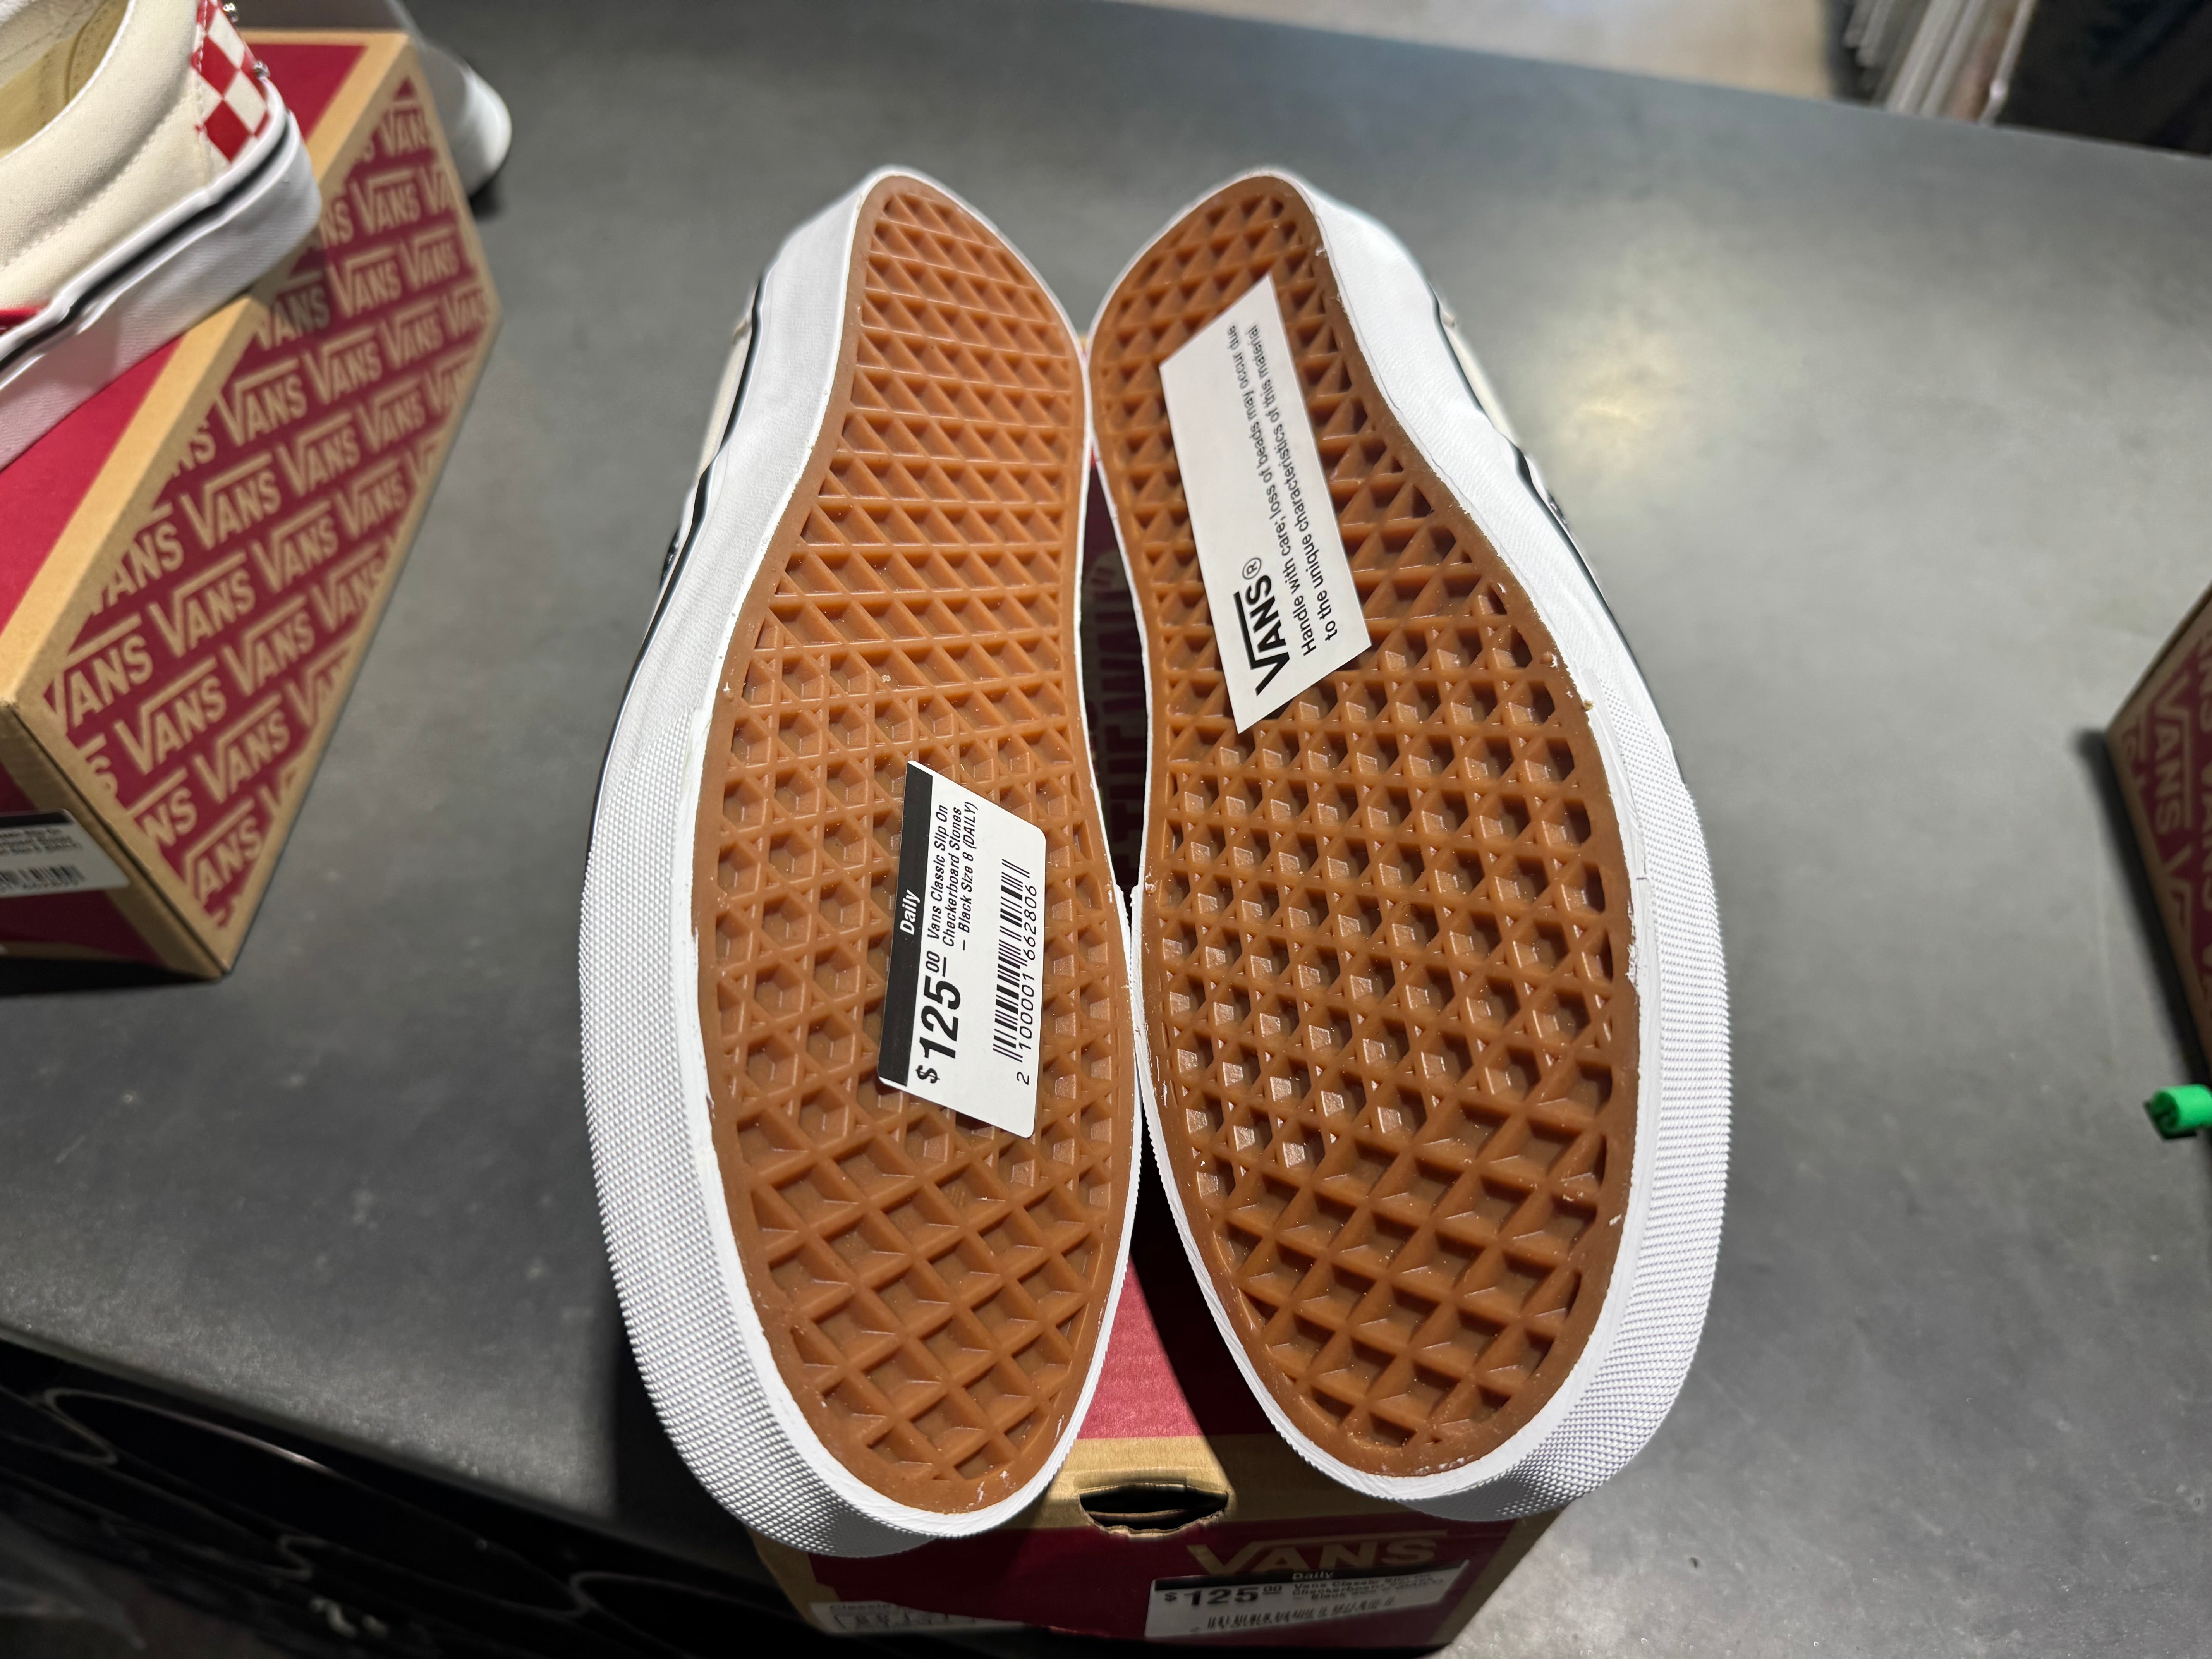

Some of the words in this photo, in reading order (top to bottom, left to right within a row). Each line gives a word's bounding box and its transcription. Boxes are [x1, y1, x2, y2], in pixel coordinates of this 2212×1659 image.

[350, 168, 421, 235] VANS
[326, 243, 403, 318] VANS
[396, 223, 461, 292] VANS
[1227, 325, 1240, 350] due
[1245, 325, 1269, 379] material
[214, 357, 308, 447] VANS
[302, 326, 382, 405] VANS
[378, 297, 444, 371] VANS
[1232, 352, 1249, 389] occur
[1242, 390, 1257, 422] may
[1260, 379, 1276, 408] this
[1265, 407, 1280, 423] of
[180, 452, 283, 551] VANS
[277, 410, 361, 499] VANS
[356, 376, 427, 453] VANS
[1249, 421, 1268, 469] beads
[1258, 467, 1273, 484] of
[1273, 424, 1309, 532] characteristics
[1266, 484, 1281, 520] loss
[148, 552, 256, 658] VANS
[251, 500, 339, 592] VANS
[336, 457, 409, 540] VANS
[1274, 516, 1291, 556] care;
[1282, 557, 1300, 595] with
[1301, 534, 1324, 589] unique
[1292, 595, 1317, 656] Handle
[1317, 590, 1332, 620] the
[1325, 620, 1338, 641] to
[113, 657, 228, 775] VANS
[221, 594, 316, 696] VANS
[195, 693, 291, 804] VANS
[936, 805, 948, 823] On
[948, 807, 962, 851] Stones
[963, 802, 979, 849] (DAILY)
[934, 826, 949, 851] Slip
[962, 852, 974, 862] 8
[930, 854, 945, 902] Classic
[942, 852, 960, 947] Checkerboard
[961, 866, 973, 893] Size
[900, 889, 921, 935] Daily
[927, 905, 942, 939] Vans
[958, 895, 972, 933] Black
[1023, 884, 1037, 960] 662806
[1019, 973, 1035, 1050] 100001
[1017, 1071, 1029, 1085] 2
[1186, 1530, 1448, 1576] VANS
[1292, 1571, 1333, 1581] Daily
